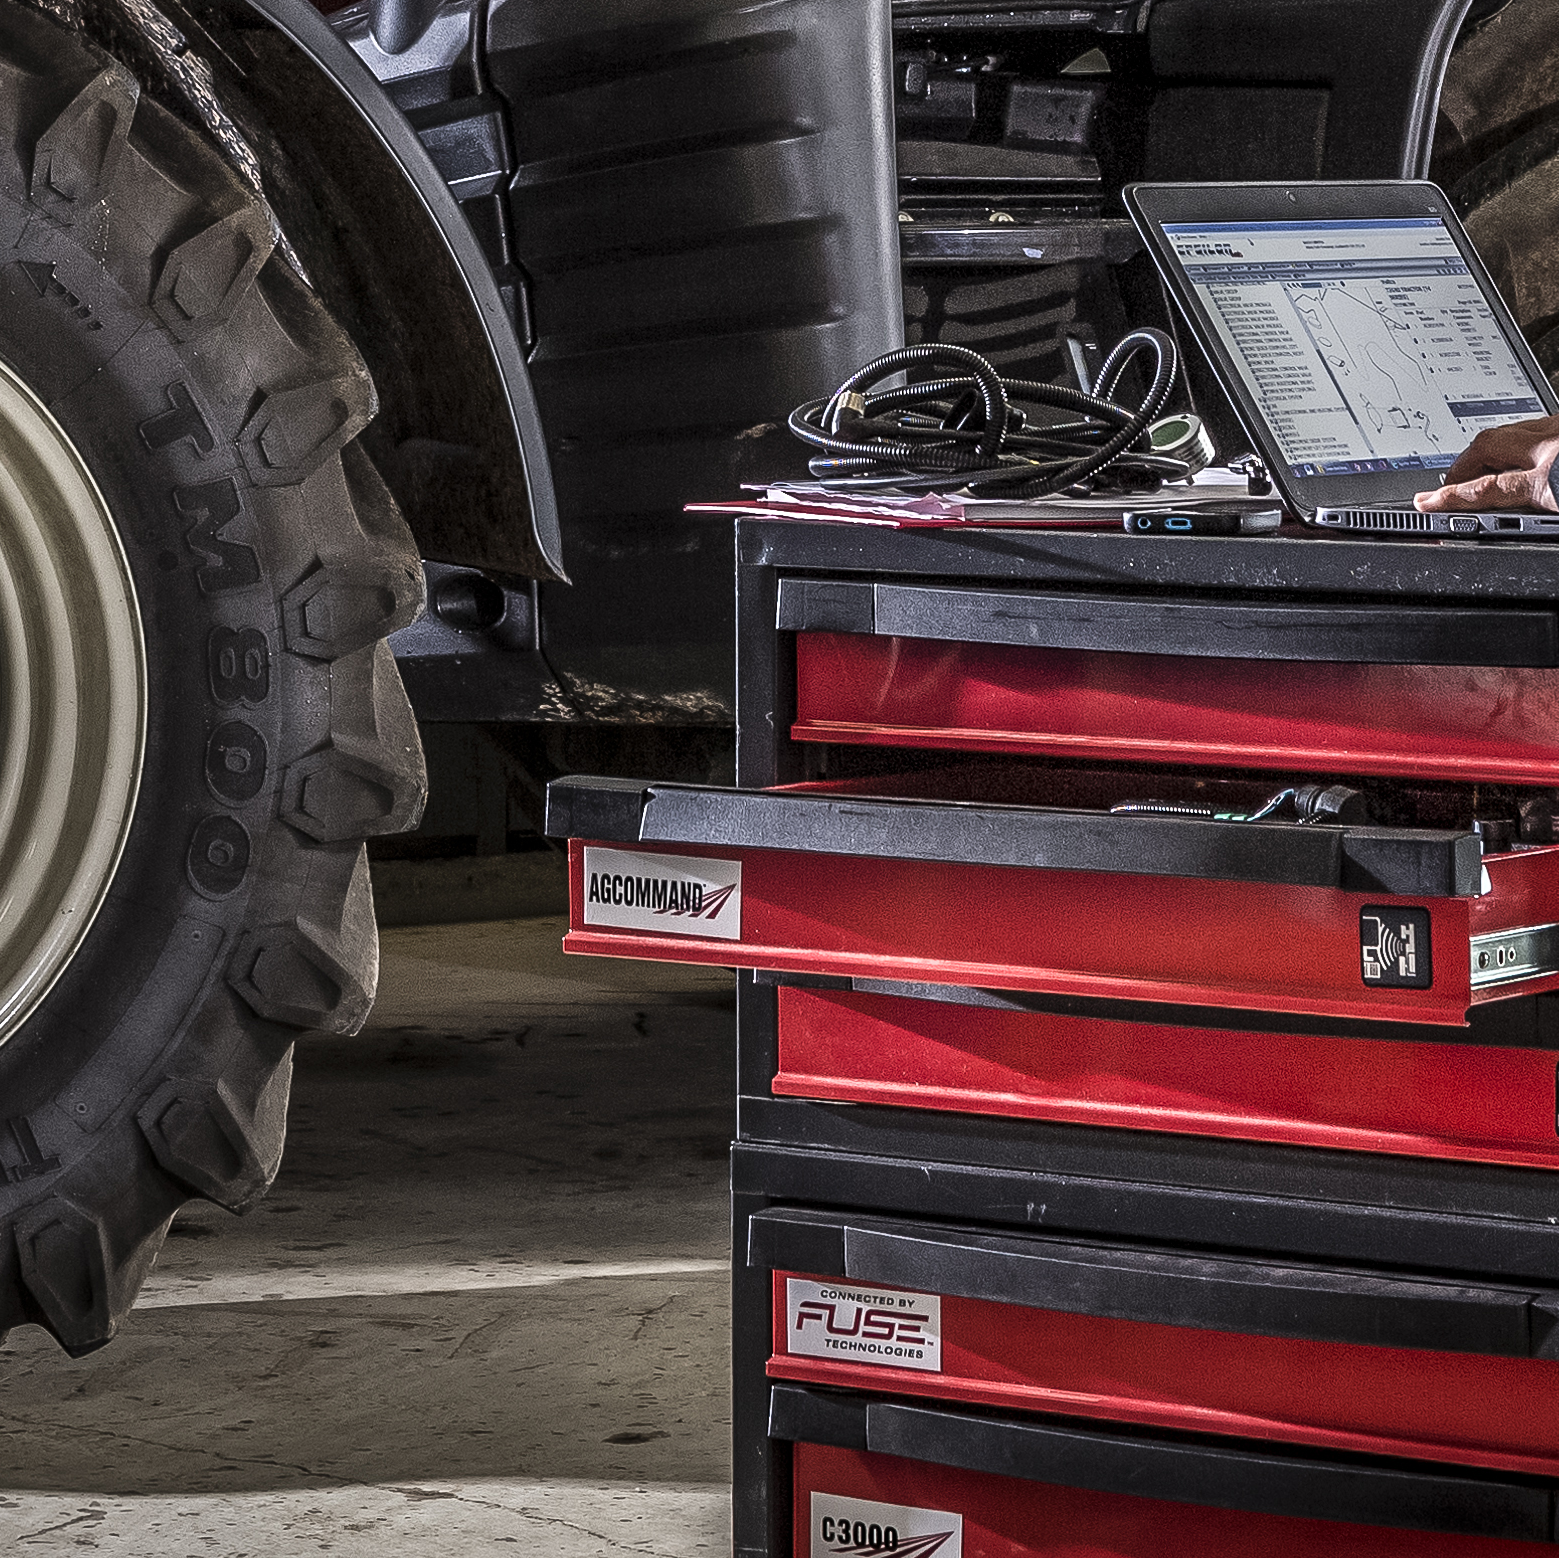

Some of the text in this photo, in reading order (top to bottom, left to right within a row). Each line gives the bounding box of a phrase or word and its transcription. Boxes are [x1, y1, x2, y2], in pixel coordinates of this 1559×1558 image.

[137, 379, 271, 902] TM800
[588, 871, 704, 915] AGCOMMAND
[820, 1289, 915, 1309] CONNECTED BY
[824, 1338, 924, 1360] TECHNOLOGIES
[821, 1515, 899, 1553] C3000
